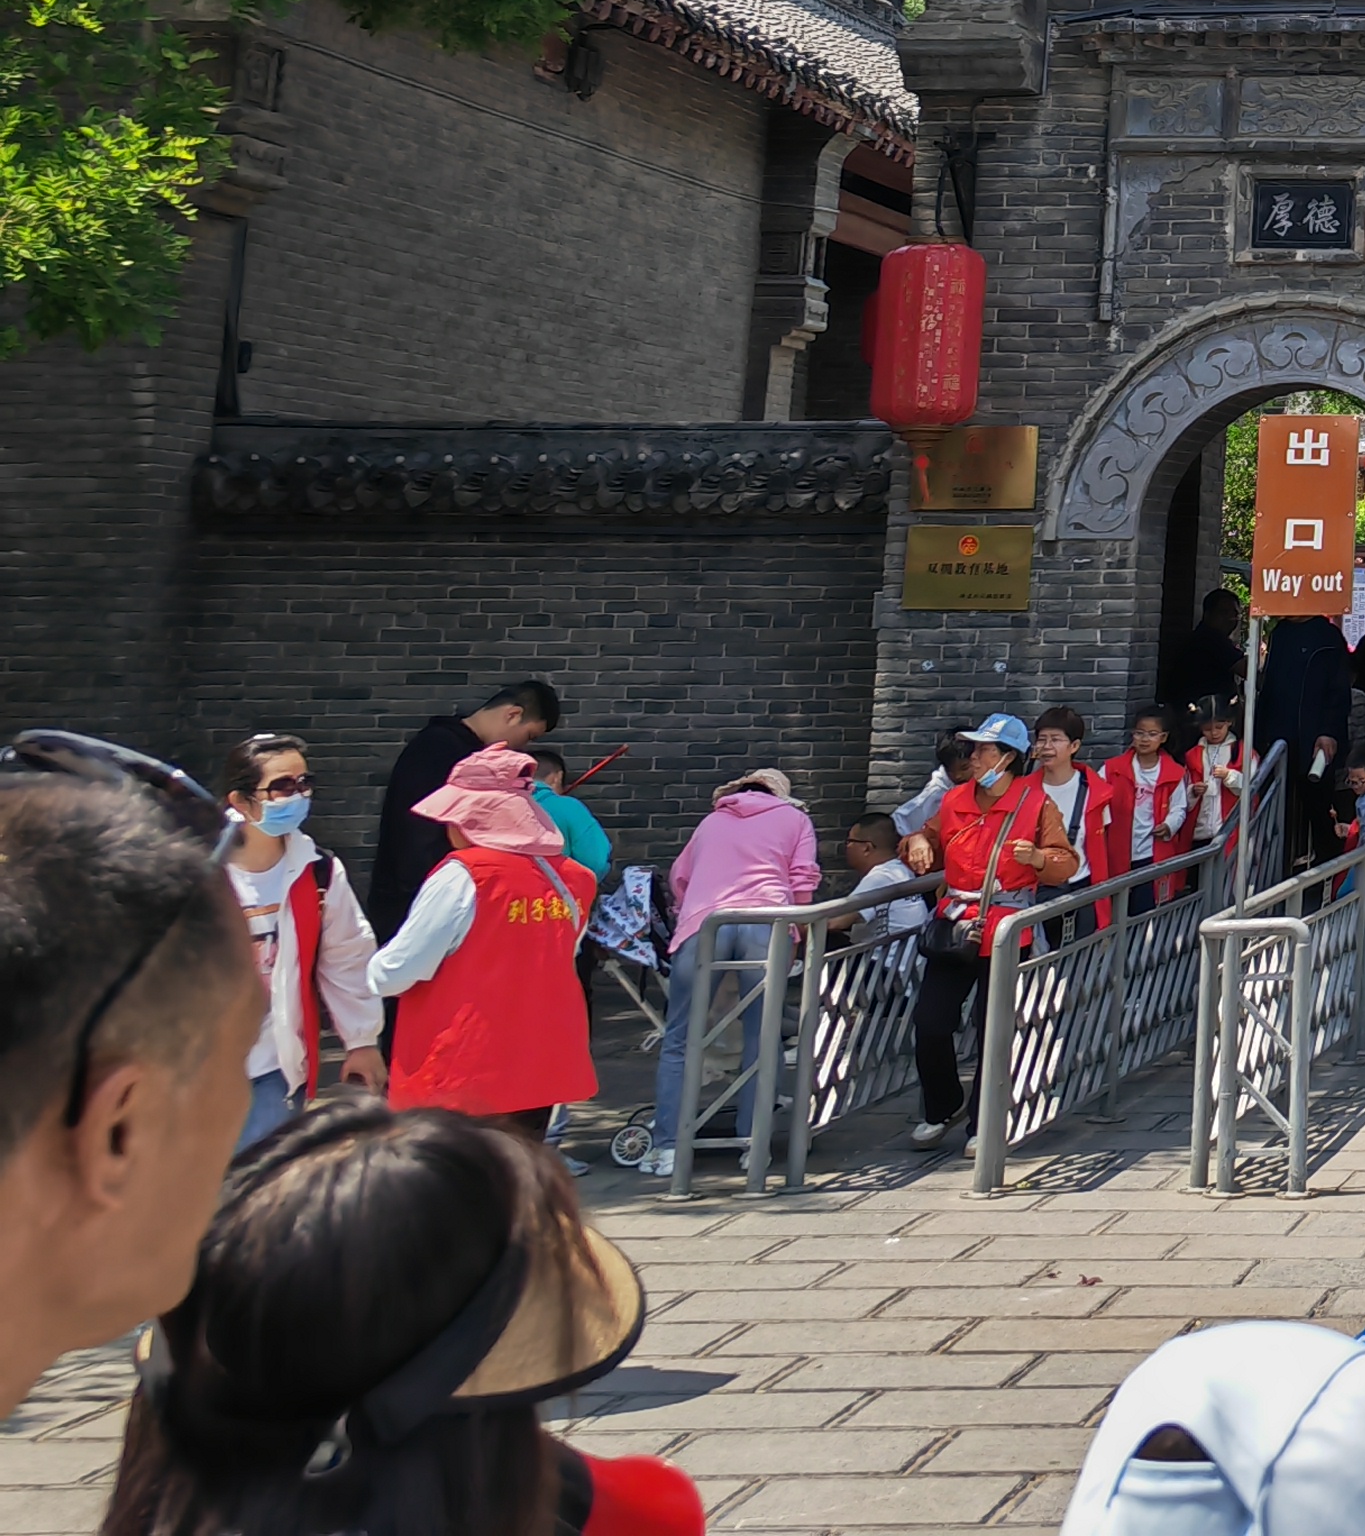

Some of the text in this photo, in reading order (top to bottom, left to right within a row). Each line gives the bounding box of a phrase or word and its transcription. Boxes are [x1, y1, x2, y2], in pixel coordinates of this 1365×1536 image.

[1263, 192, 1341, 237] 厚德
[1284, 428, 1330, 551] 出口
[1262, 568, 1344, 597] Way out
